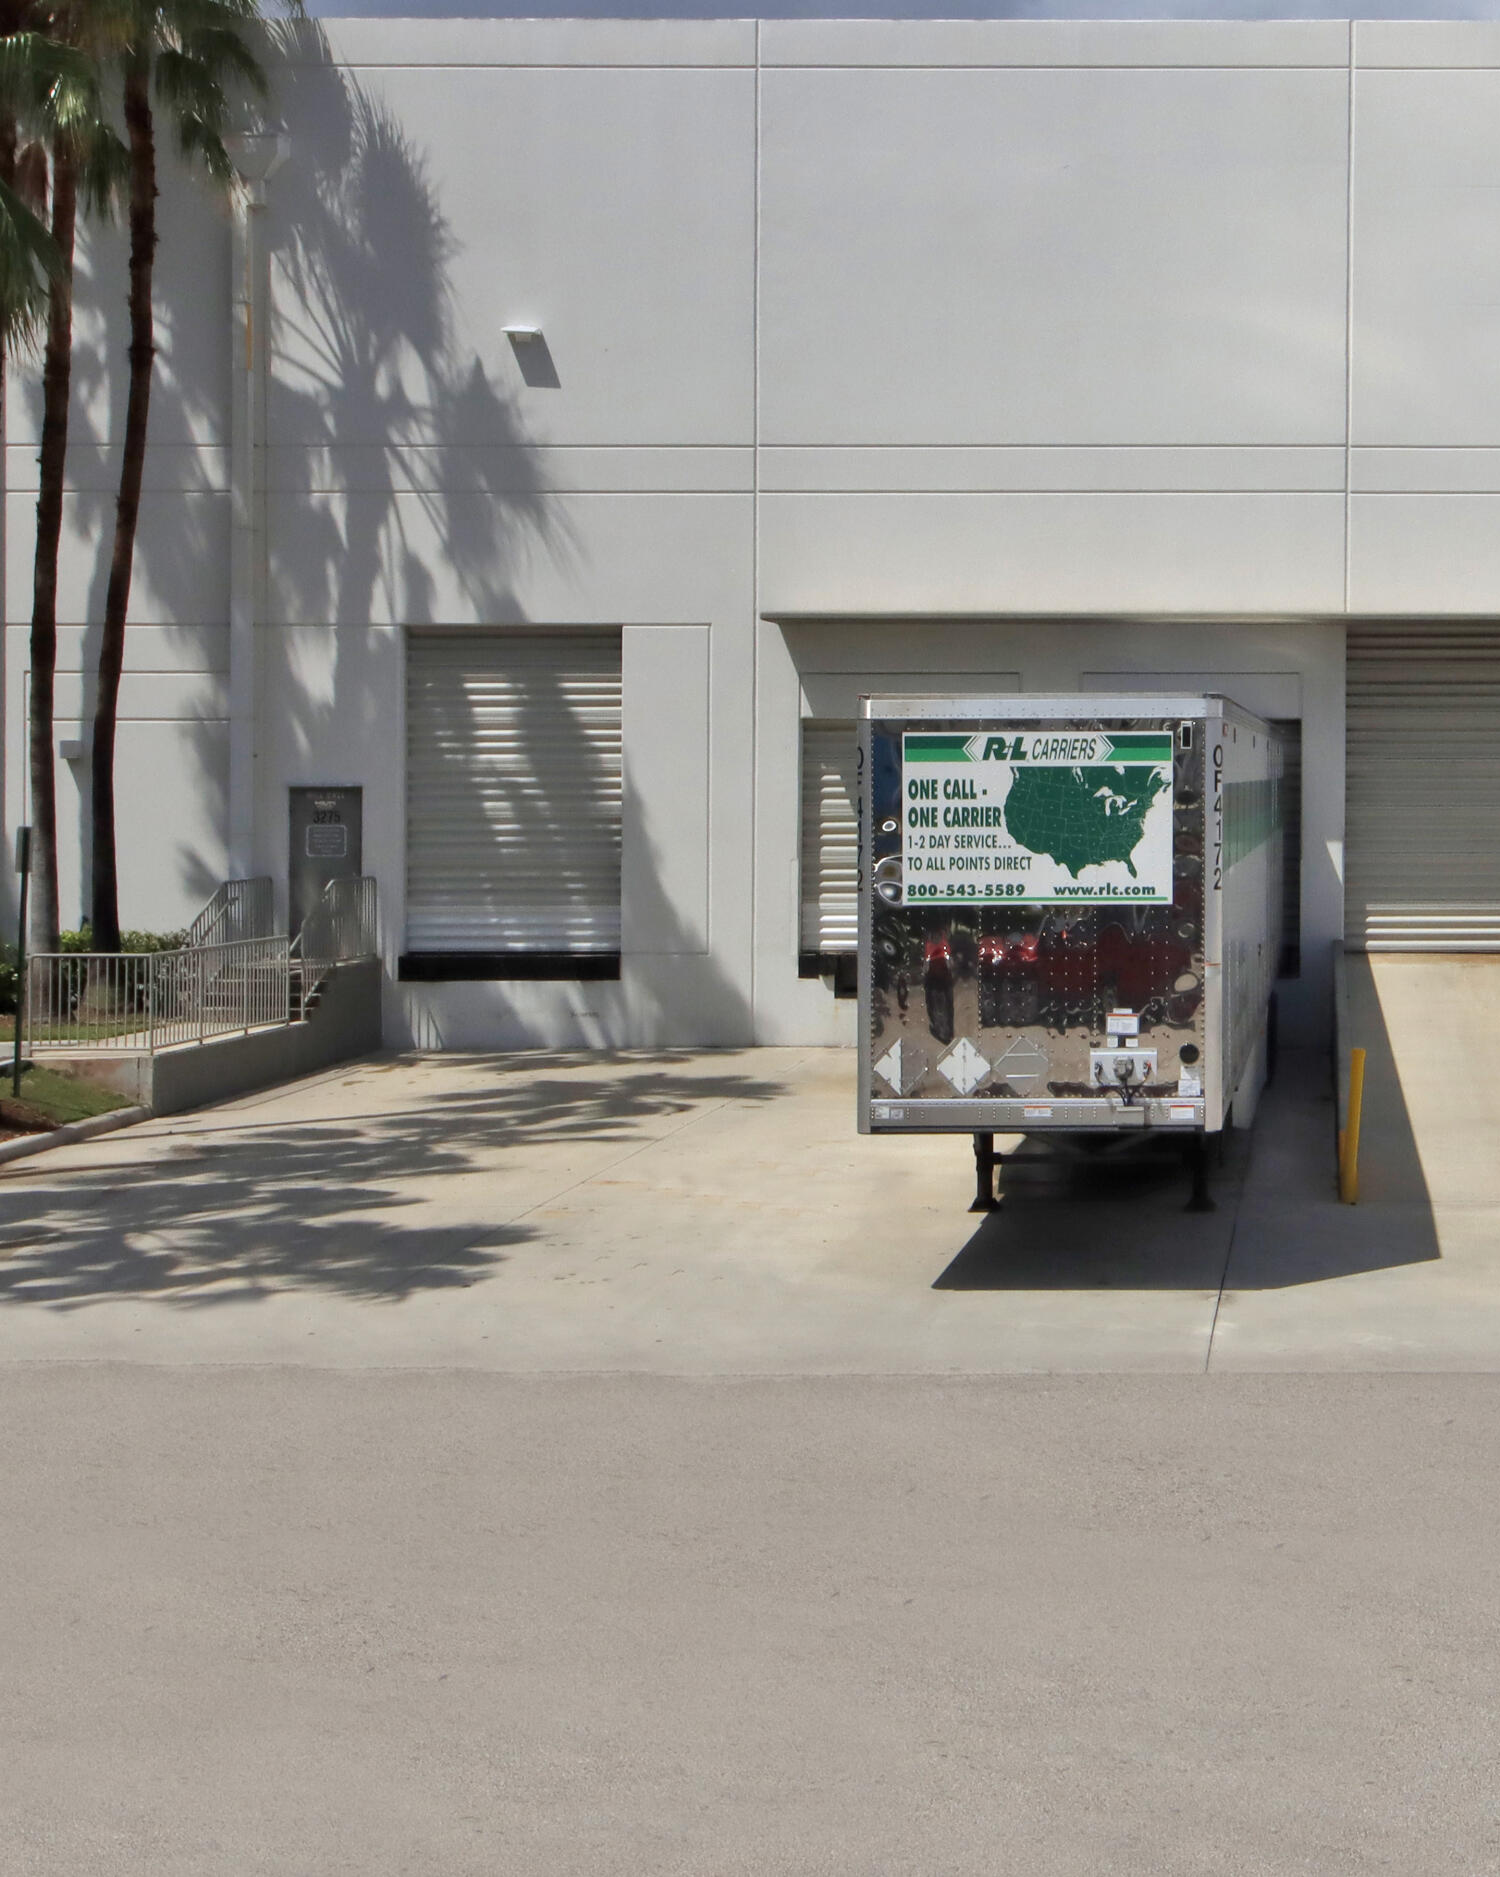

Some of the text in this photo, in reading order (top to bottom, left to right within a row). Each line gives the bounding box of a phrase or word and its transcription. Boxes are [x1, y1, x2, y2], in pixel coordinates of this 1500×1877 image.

[1032, 738, 1097, 761] CARRIERS
[908, 779, 938, 800] ONE
[943, 779, 977, 800] CALL
[313, 810, 341, 825] 3275
[908, 806, 1002, 828] ONE CARRIER
[908, 834, 1012, 849] 1-2 DAY SERVICE...
[908, 856, 1032, 871] TO ALL POINTS DIRECT
[908, 882, 1156, 897] 800-543-5589 www.rlc.com
